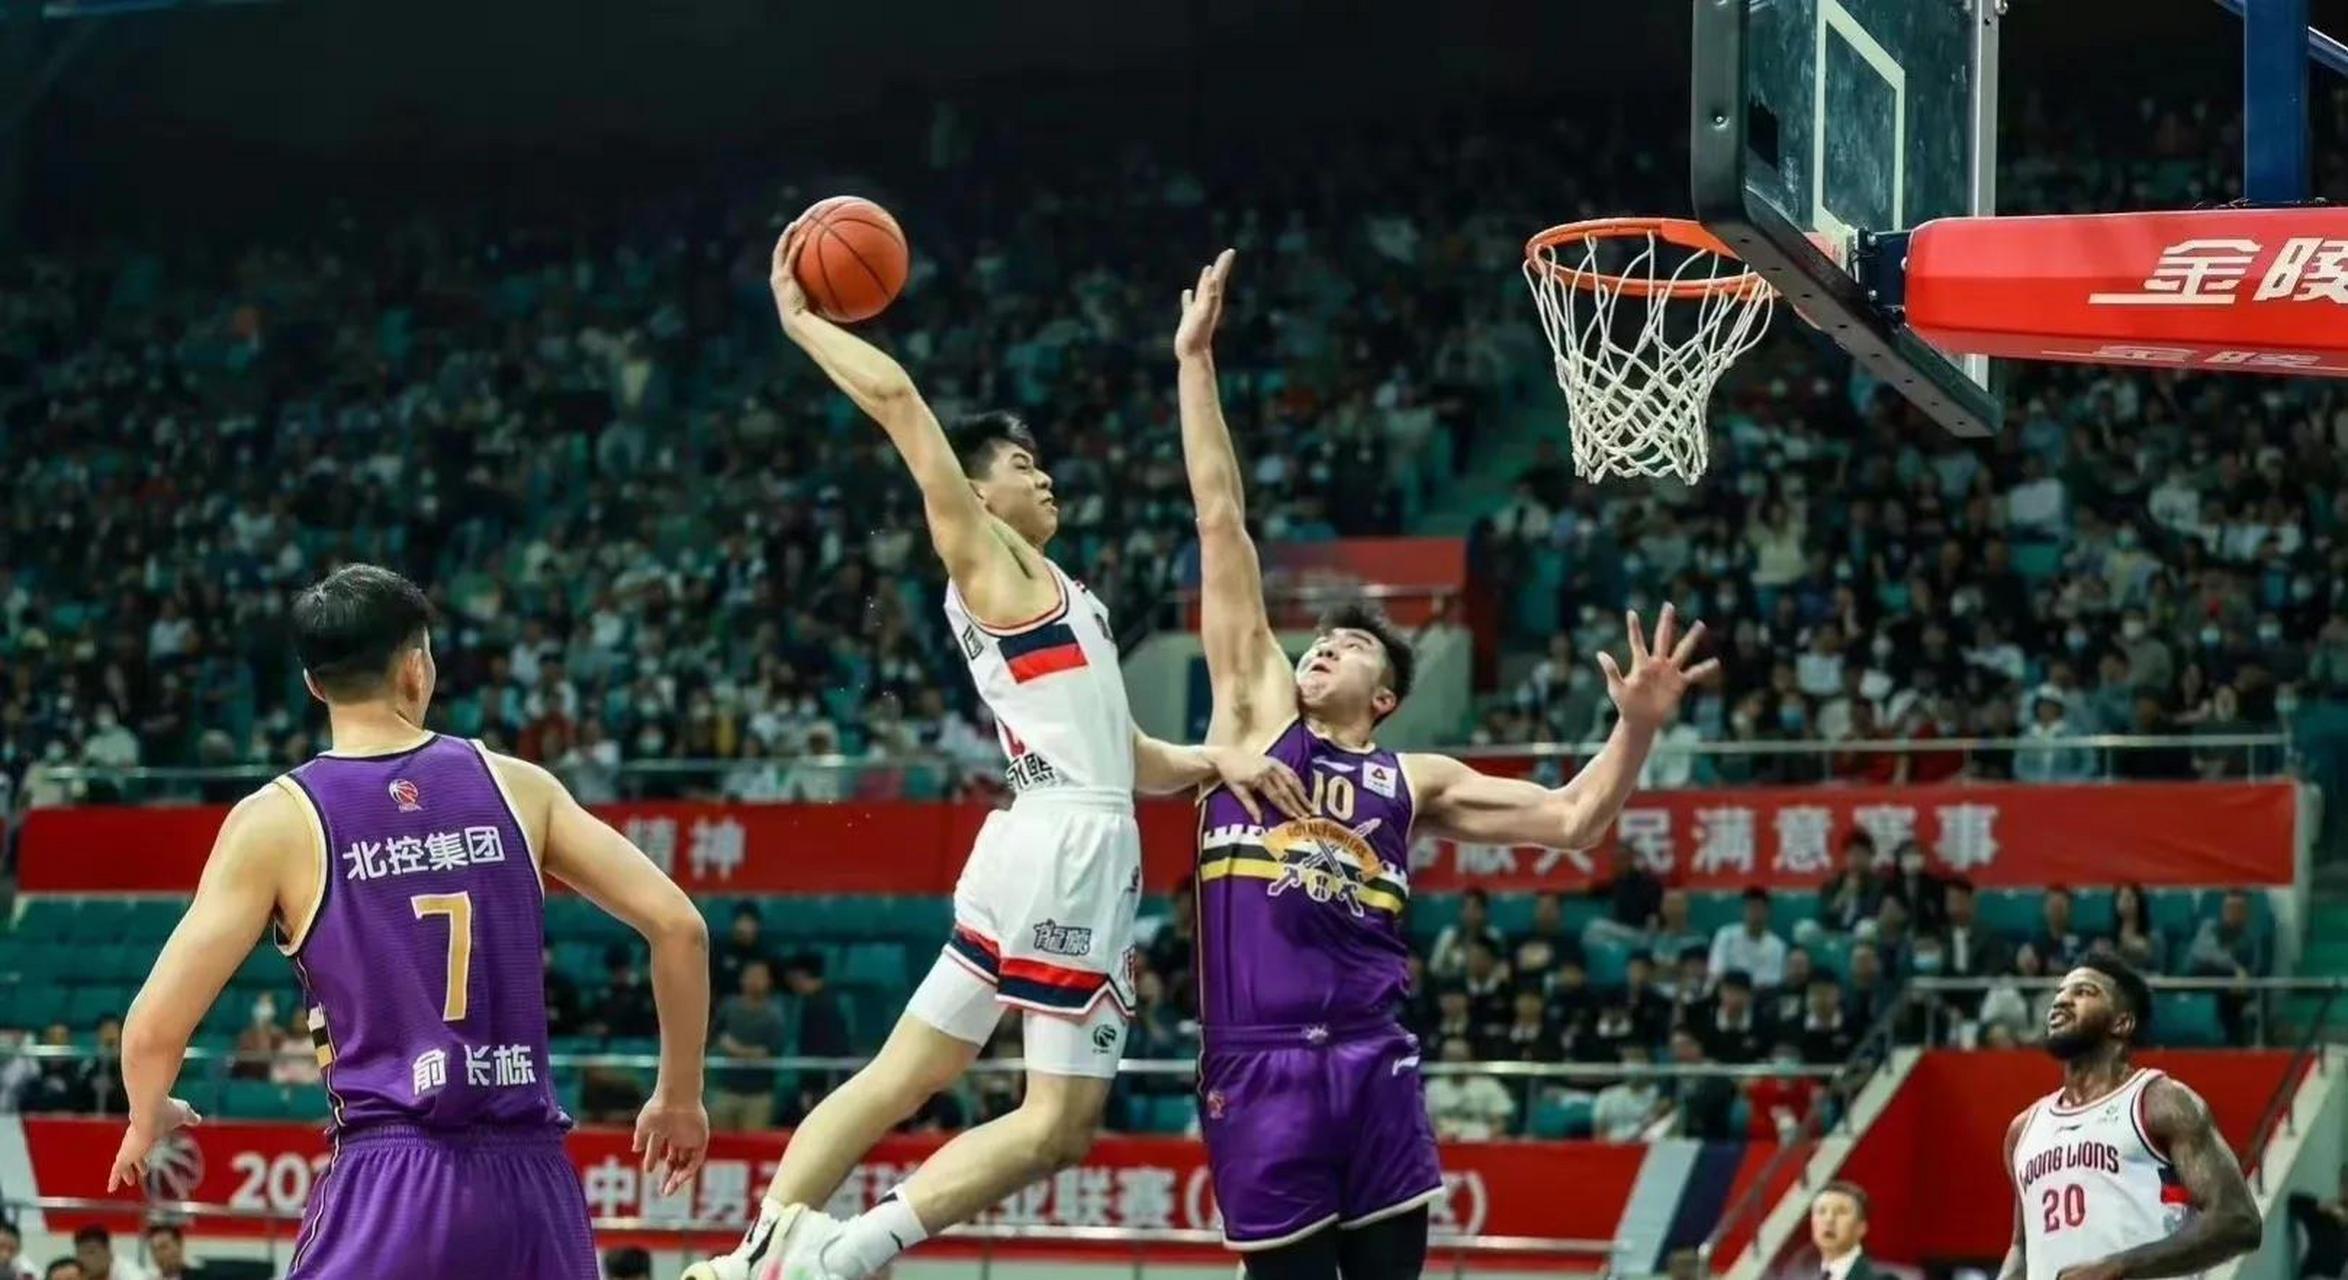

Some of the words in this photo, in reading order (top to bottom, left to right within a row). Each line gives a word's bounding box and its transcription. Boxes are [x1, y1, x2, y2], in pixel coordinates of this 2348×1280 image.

[2088, 237, 2348, 304] 金陵
[1312, 770, 1355, 821] 10
[342, 826, 506, 881] 北控集团
[410, 890, 472, 1021] 7
[2066, 1140, 2120, 1175] LIONS
[2041, 1182, 2086, 1234] 20
